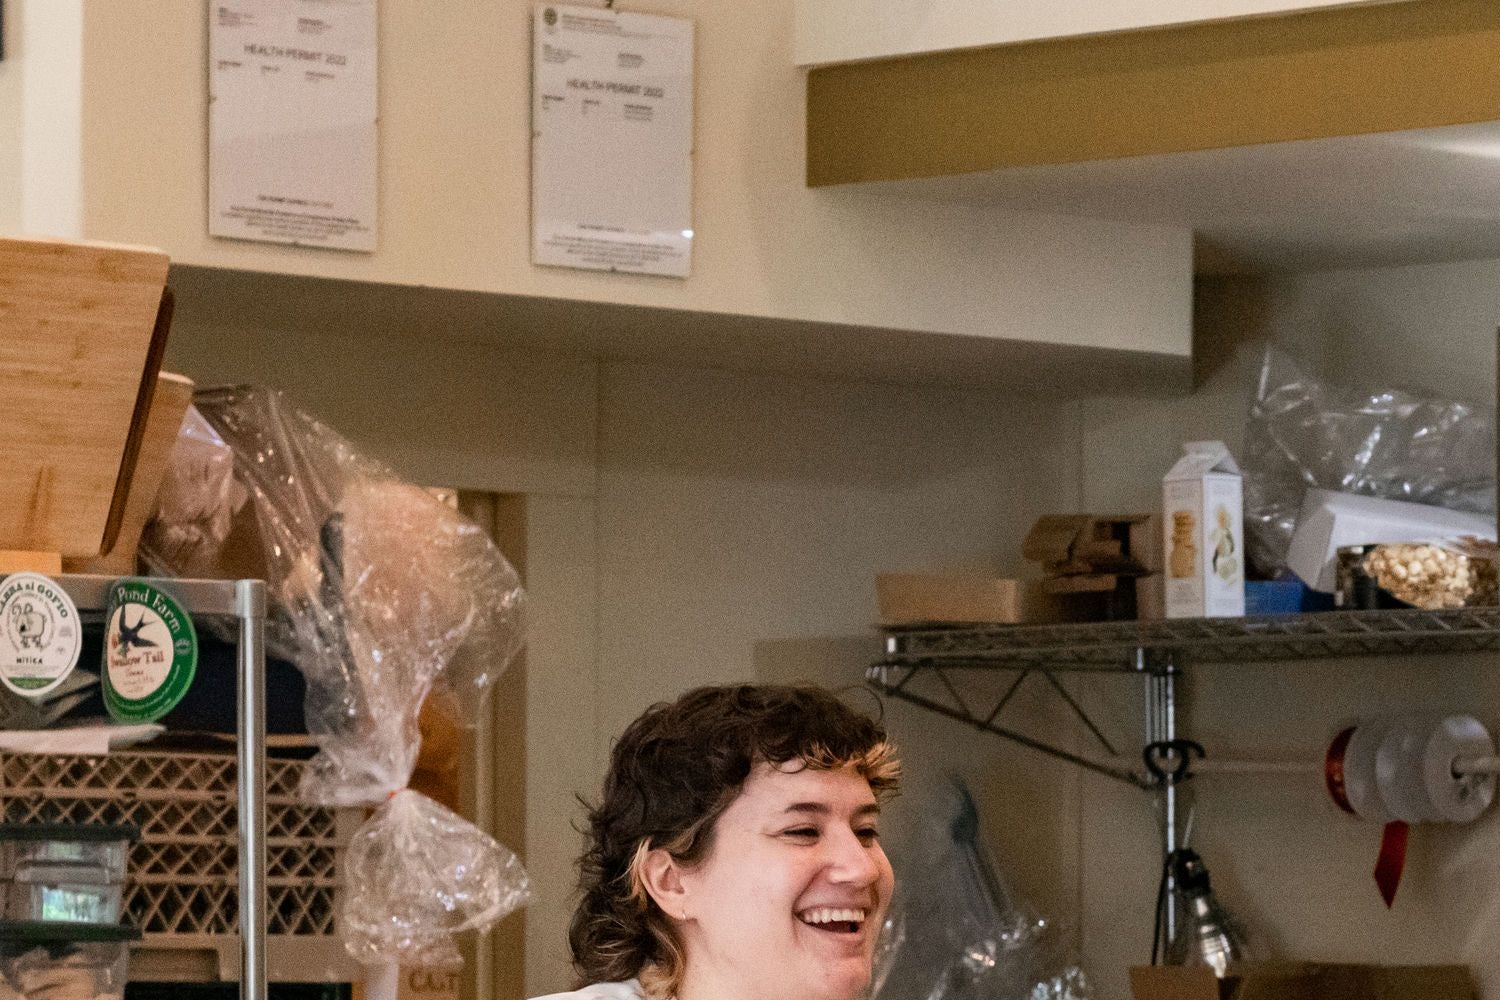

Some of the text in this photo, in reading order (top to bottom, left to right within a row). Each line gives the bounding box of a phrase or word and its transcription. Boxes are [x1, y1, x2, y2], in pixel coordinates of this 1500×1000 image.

[244, 44, 284, 56] HEALTH
[285, 48, 322, 61] PERMIT
[566, 79, 604, 90] HEALTH
[605, 81, 641, 94] PERMIT
[37, 584, 68, 618] GOFIO
[117, 586, 181, 633] Pond Farm
